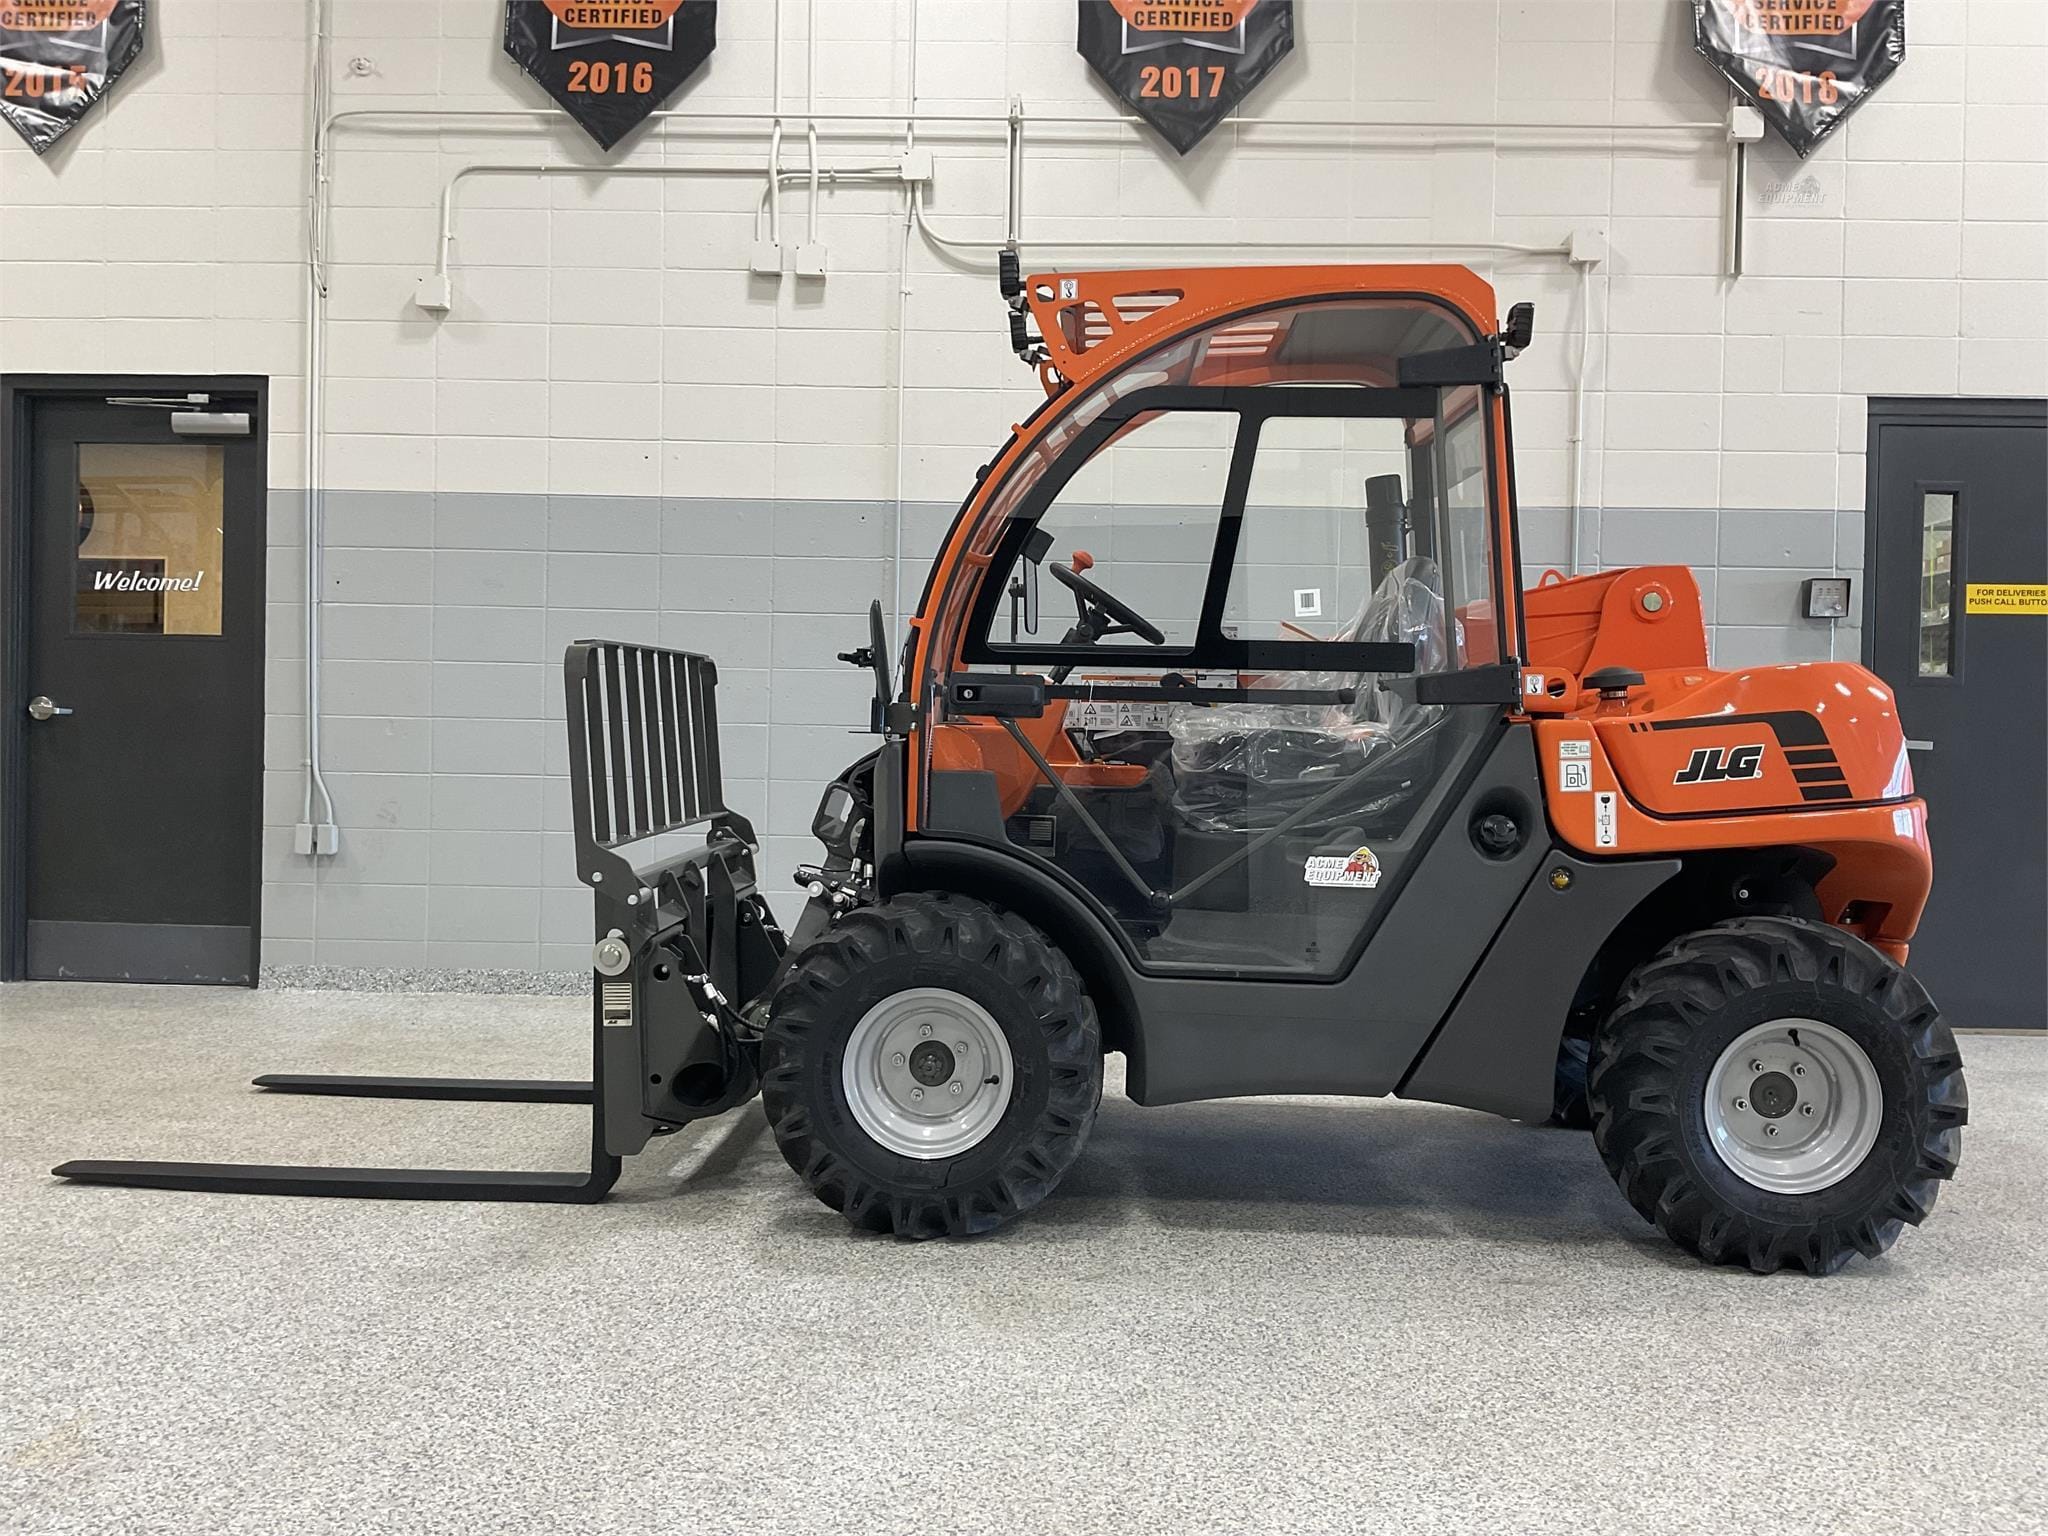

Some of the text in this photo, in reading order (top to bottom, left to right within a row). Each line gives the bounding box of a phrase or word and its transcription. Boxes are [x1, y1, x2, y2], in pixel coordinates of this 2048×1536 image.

[2, 11, 96, 27] CERTIFIED
[564, 8, 662, 24] CERTIFIED
[1134, 10, 1233, 27] CERTIFIED
[1744, 14, 1845, 30] CERTIFIED
[567, 60, 653, 94] 2016
[1140, 65, 1225, 98] 2017
[94, 570, 205, 592] Welcome!
[1976, 589, 2046, 597] FOR DELIVERIES
[1673, 743, 1765, 785] JLG
[1307, 858, 1344, 869] ACME
[1307, 869, 1380, 882] EQUIPMENT
